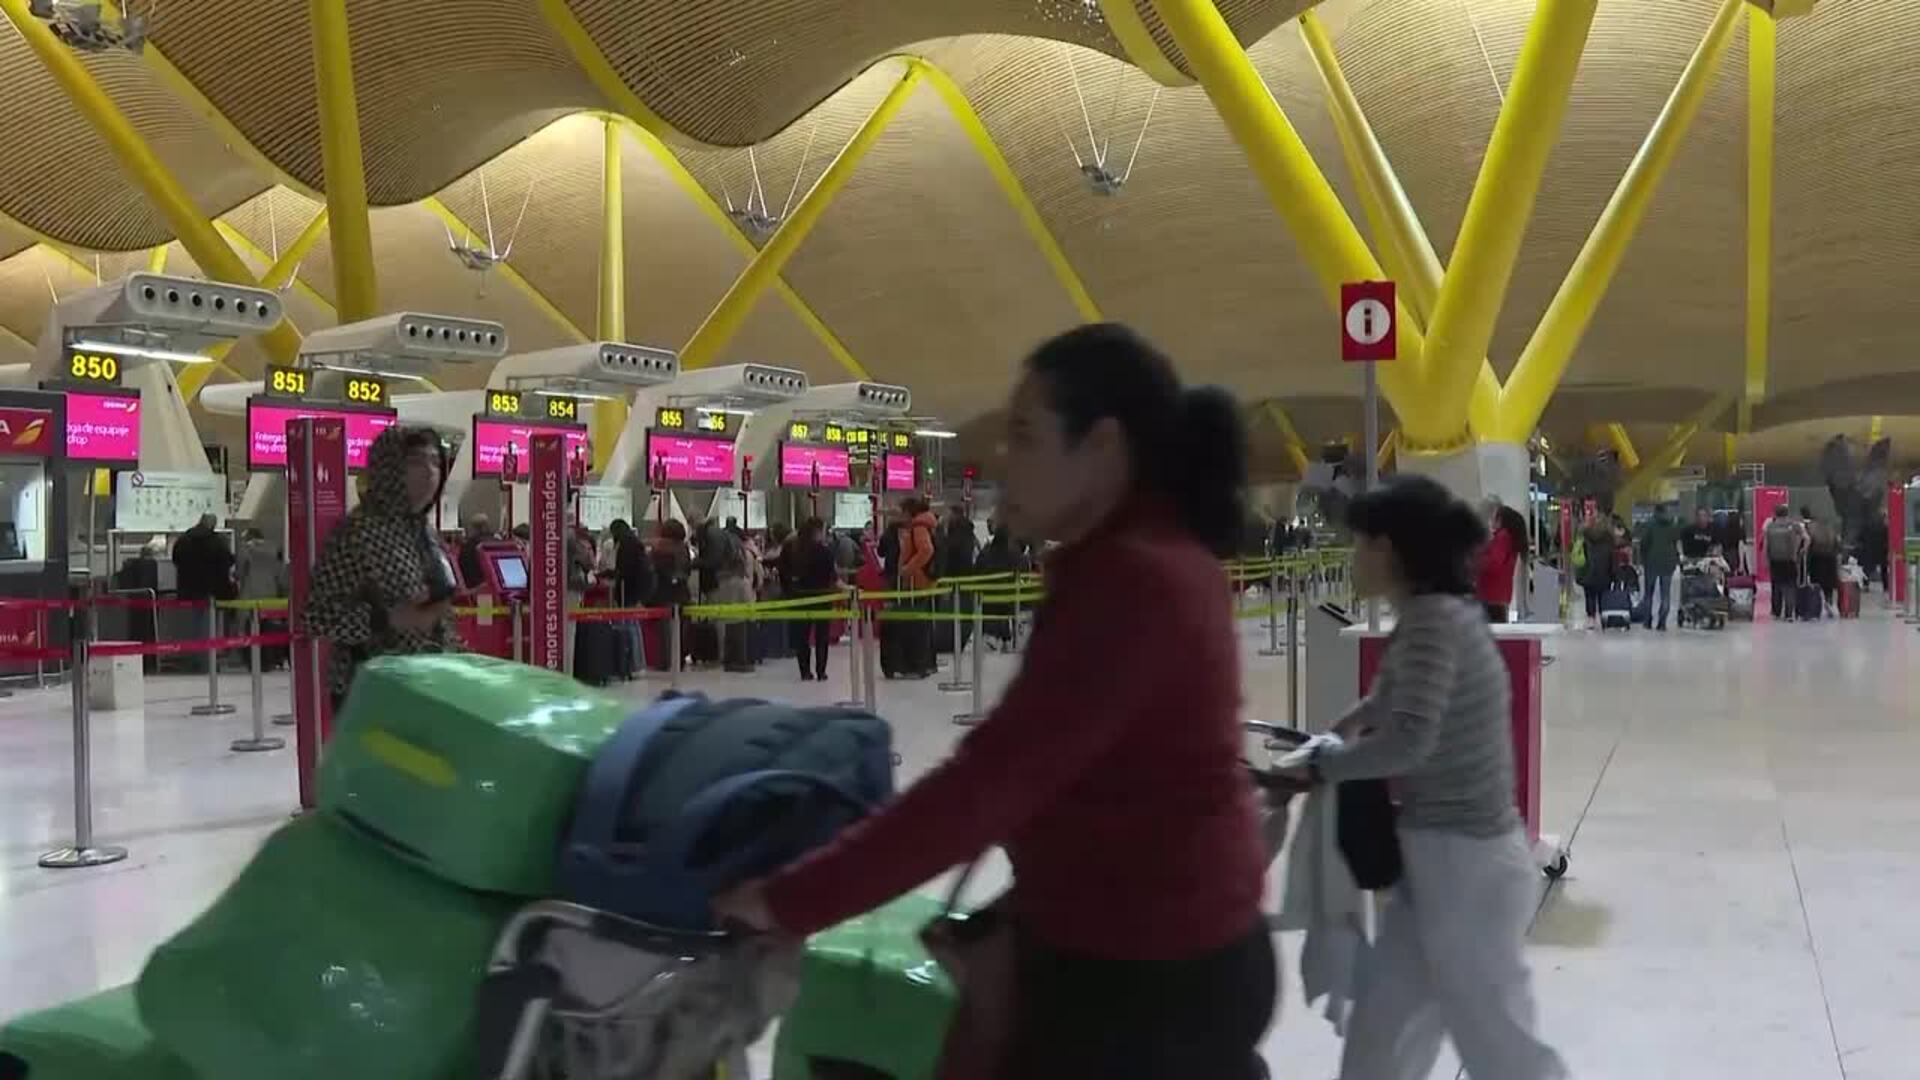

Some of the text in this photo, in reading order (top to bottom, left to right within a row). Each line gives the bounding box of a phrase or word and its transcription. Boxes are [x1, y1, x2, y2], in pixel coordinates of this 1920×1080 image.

[72, 355, 116, 379] 850
[273, 371, 305, 393] 851
[349, 381, 380, 401] 852
[492, 394, 518, 412] 853
[549, 400, 574, 418] 854
[661, 410, 682, 427] 855
[541, 471, 560, 586] acompañados
[545, 588, 557, 611] no
